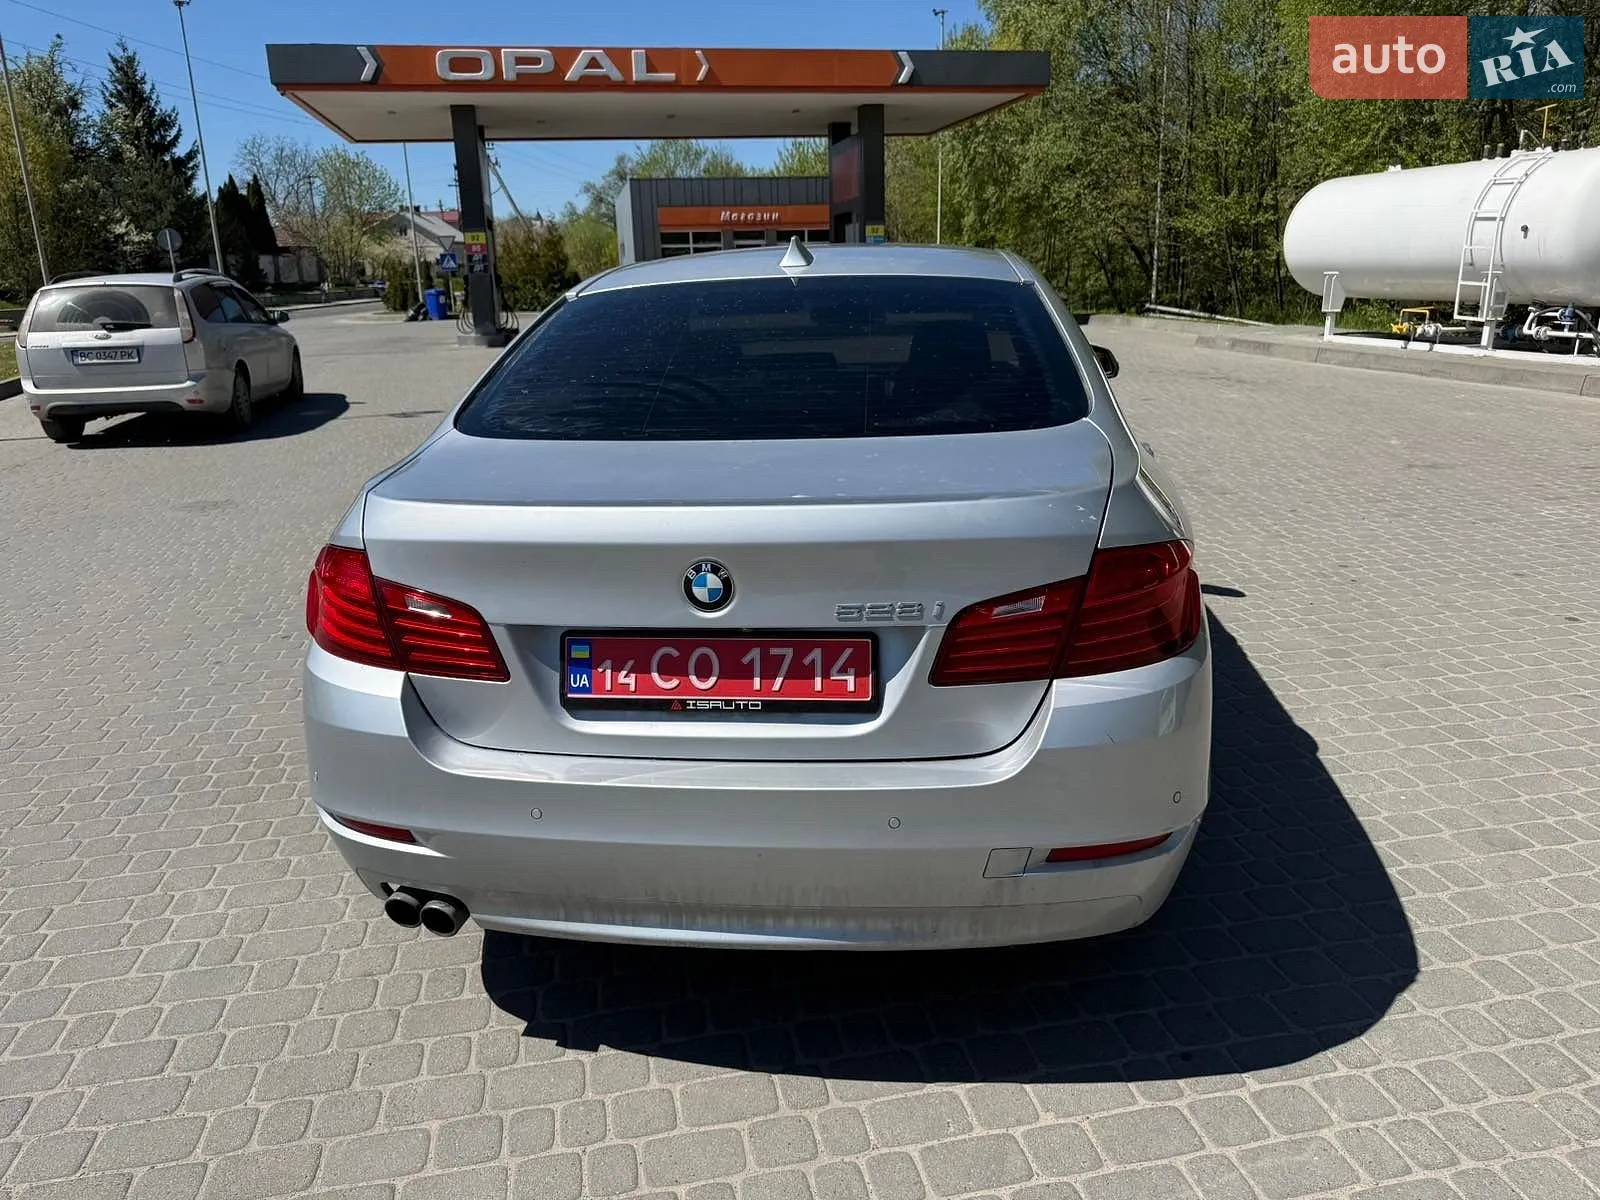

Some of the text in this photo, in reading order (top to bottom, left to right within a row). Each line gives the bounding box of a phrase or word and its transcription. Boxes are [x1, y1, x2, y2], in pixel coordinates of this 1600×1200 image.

[435, 48, 676, 82] OPAL
[79, 350, 134, 362] BC 0347 PK
[687, 563, 729, 580] BMW
[597, 645, 856, 693] 14 CO 1714
[570, 673, 589, 688] UA
[685, 701, 762, 711] ISAUTO
